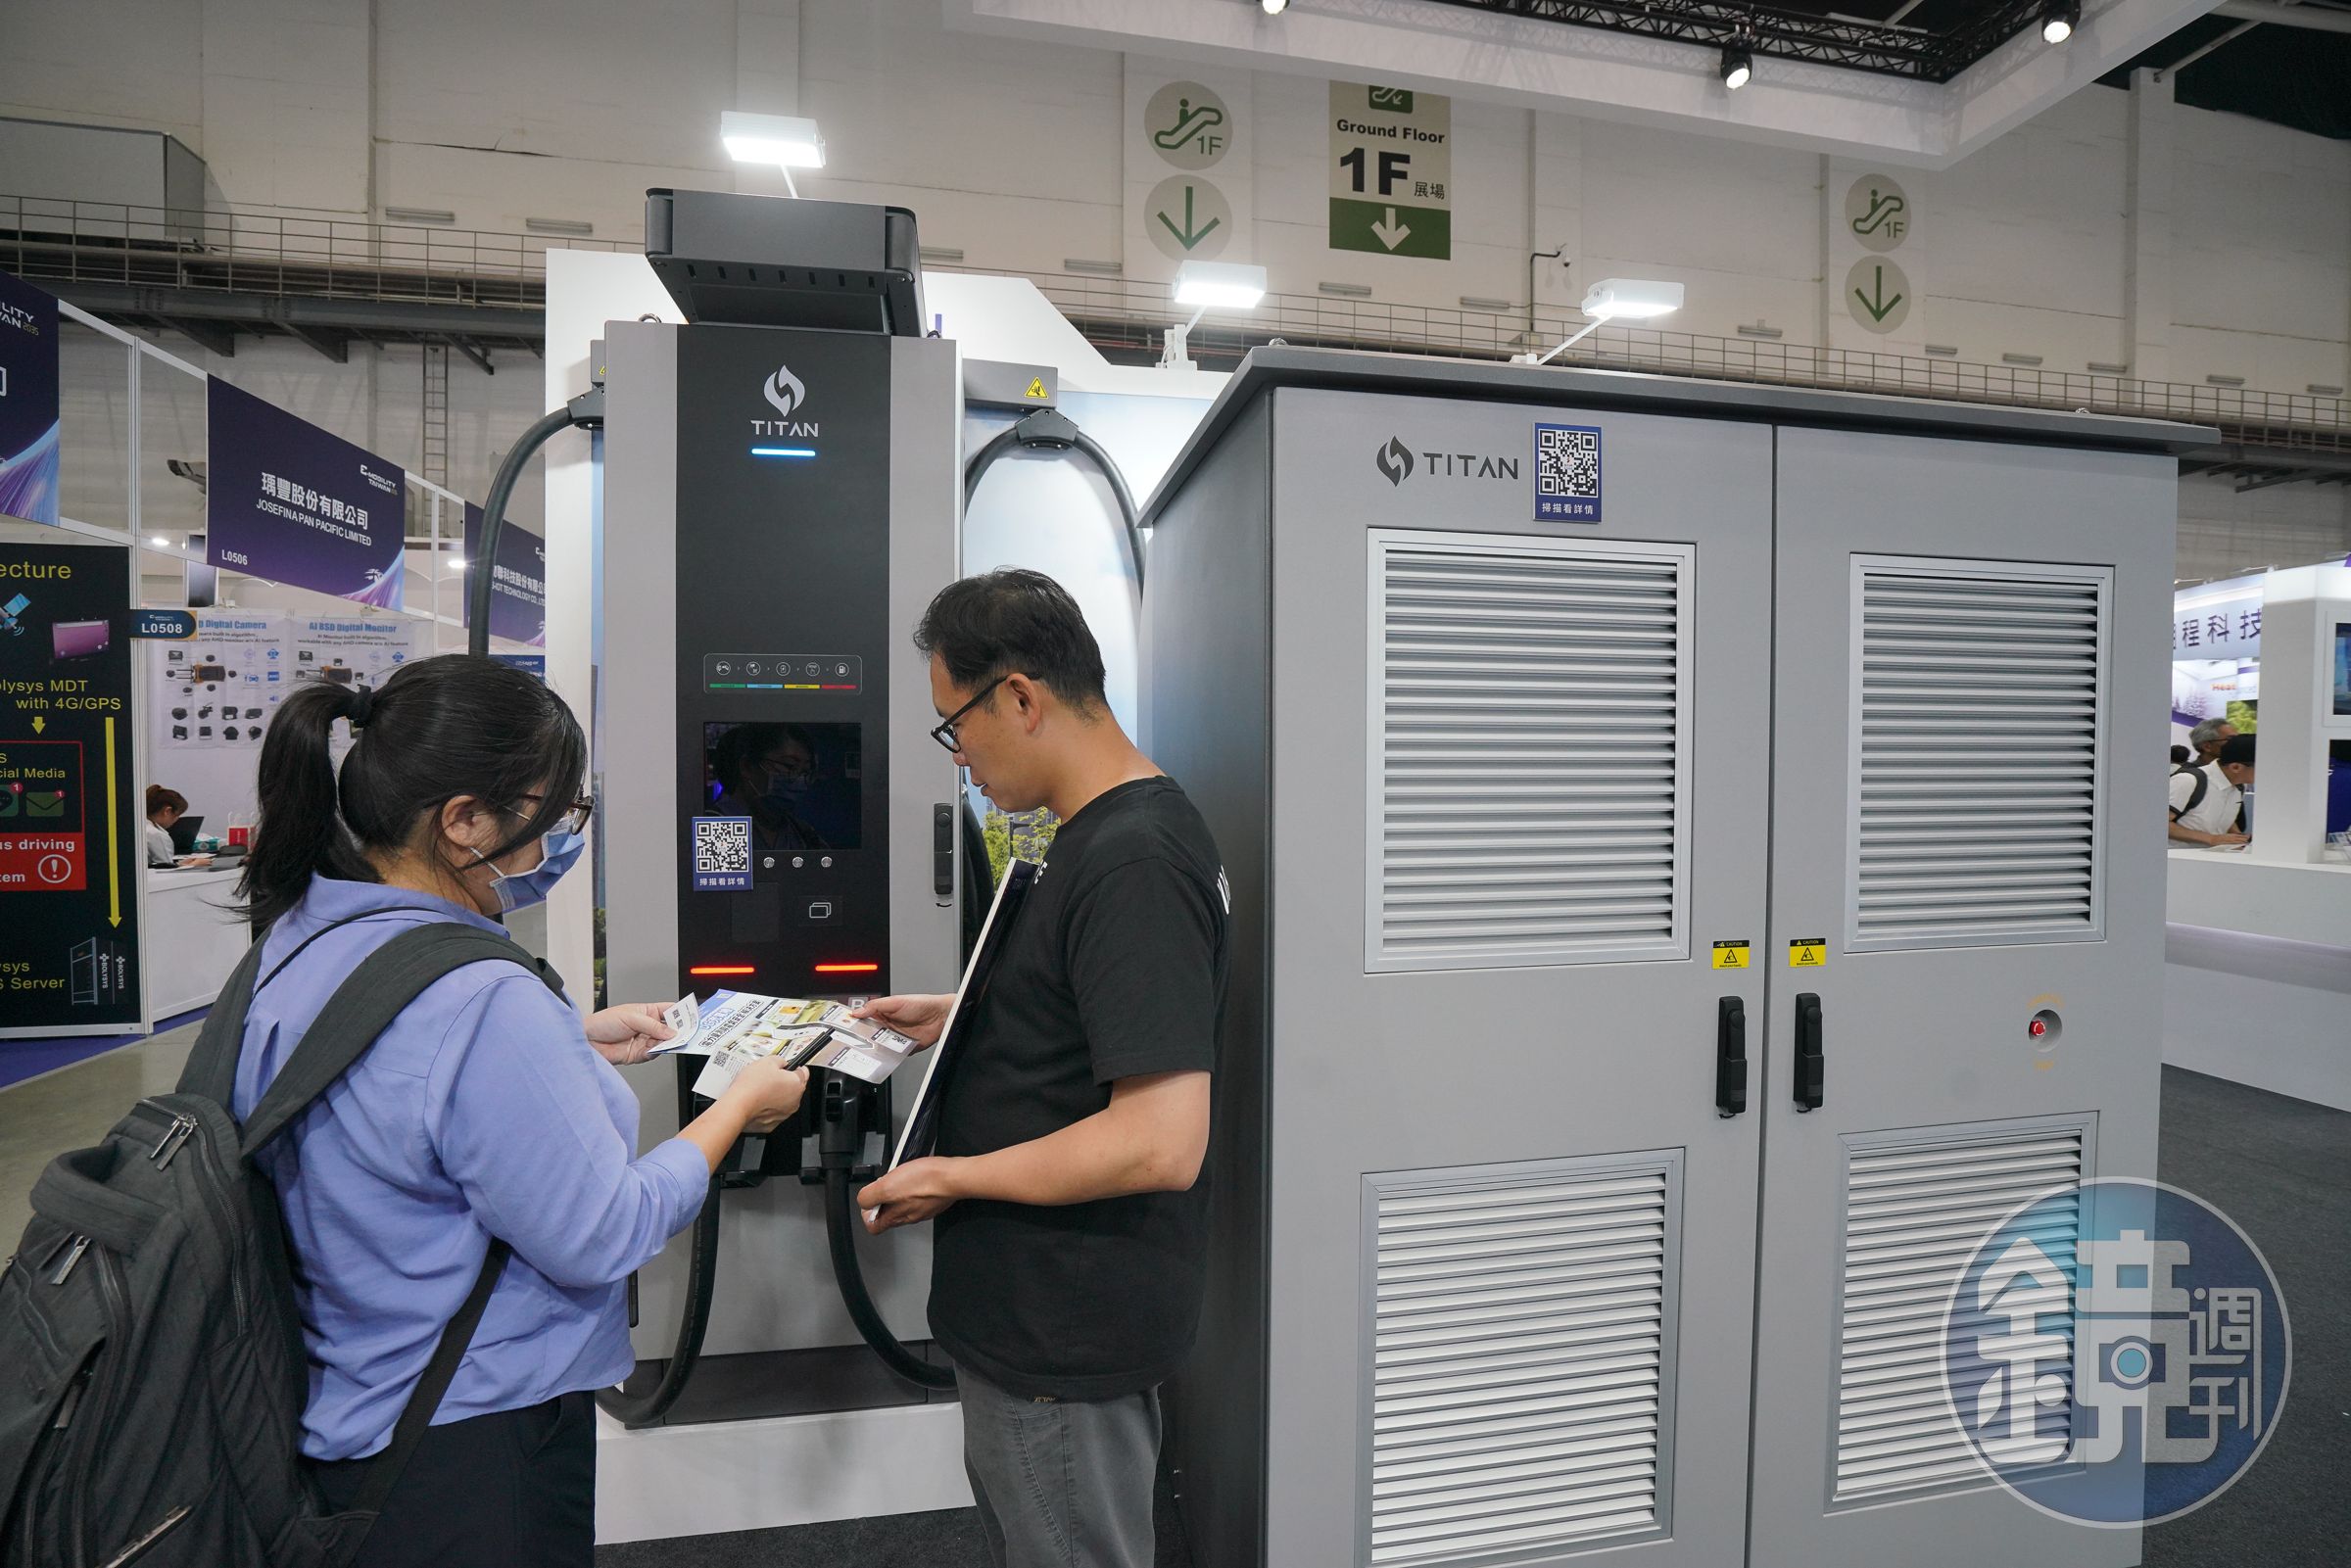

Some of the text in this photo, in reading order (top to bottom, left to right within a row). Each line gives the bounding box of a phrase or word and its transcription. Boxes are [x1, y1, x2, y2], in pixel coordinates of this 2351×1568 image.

[1336, 119, 1446, 144] Ground Floor
[1197, 135, 1223, 156] 1F
[1340, 147, 1445, 200] 1F 展場
[1884, 221, 1905, 239] 1F
[0, 301, 34, 323] LITY
[0, 311, 21, 329] AN
[750, 419, 819, 438] TITAN
[1422, 451, 1519, 481] TITAN
[261, 471, 368, 531] 瑀豐股份有限公司
[1542, 501, 1594, 515] 掃描看詳情
[256, 498, 372, 546] JOSEFINA PAN PACIFIC LIMITED
[221, 548, 248, 566] L0506
[141, 623, 183, 634] L0508
[206, 620, 232, 630] Digital
[235, 621, 266, 630] Camera
[318, 622, 335, 632] BSD
[337, 623, 363, 633] Digital
[364, 624, 397, 633] Monitor
[2174, 608, 2261, 650] 程科技
[0, 679, 88, 694] lysys MDT
[16, 696, 121, 710] with 4G/GPS
[24, 768, 66, 779] Media
[19, 839, 75, 853] driving
[0, 873, 25, 882] em
[698, 877, 744, 886] 掃描看詳情
[0, 963, 30, 974] sys
[11, 977, 66, 989] Server
